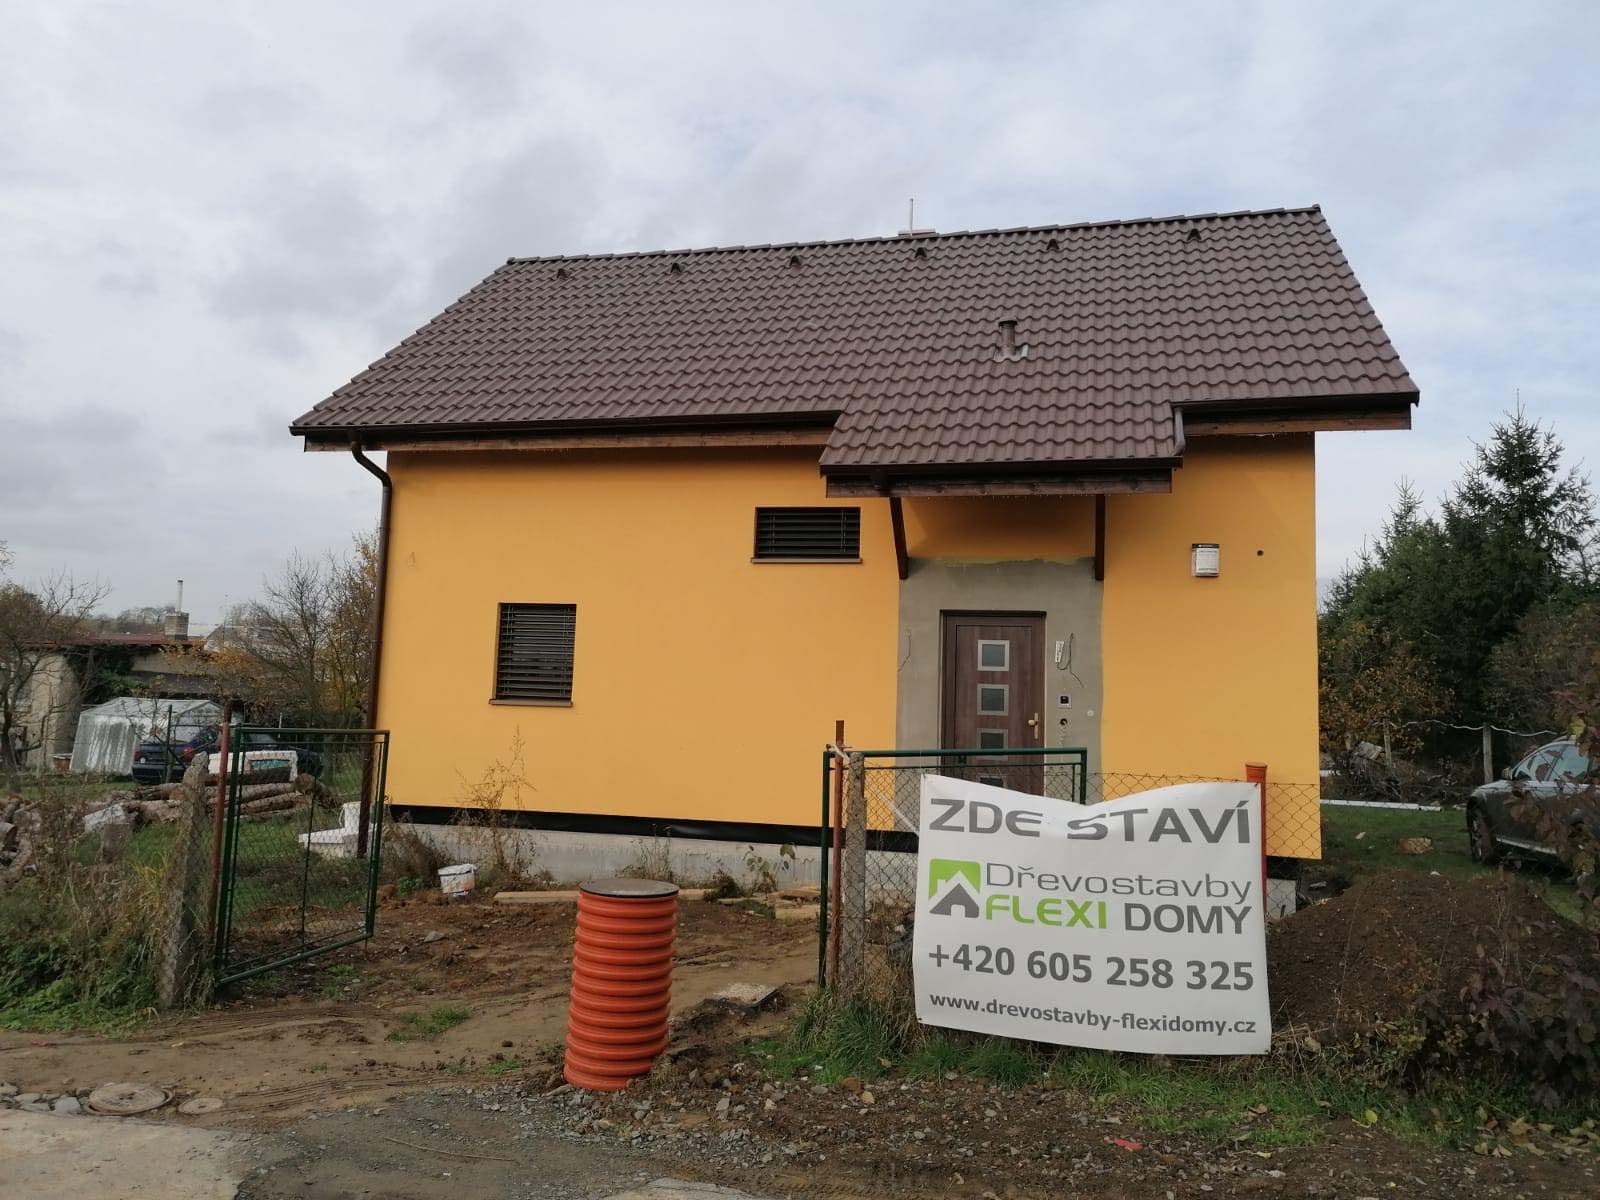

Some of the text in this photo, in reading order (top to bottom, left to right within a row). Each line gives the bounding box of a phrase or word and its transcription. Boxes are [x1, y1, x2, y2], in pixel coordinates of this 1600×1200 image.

[928, 798, 1251, 844] ZDE STAVÍ
[986, 862, 1252, 905] Dřevostavby
[985, 894, 1252, 934] FLEXI DOMY
[928, 943, 1254, 991] +420 605 258 325
[930, 992, 1256, 1036] www.drevostavby-flexidomy.cz
